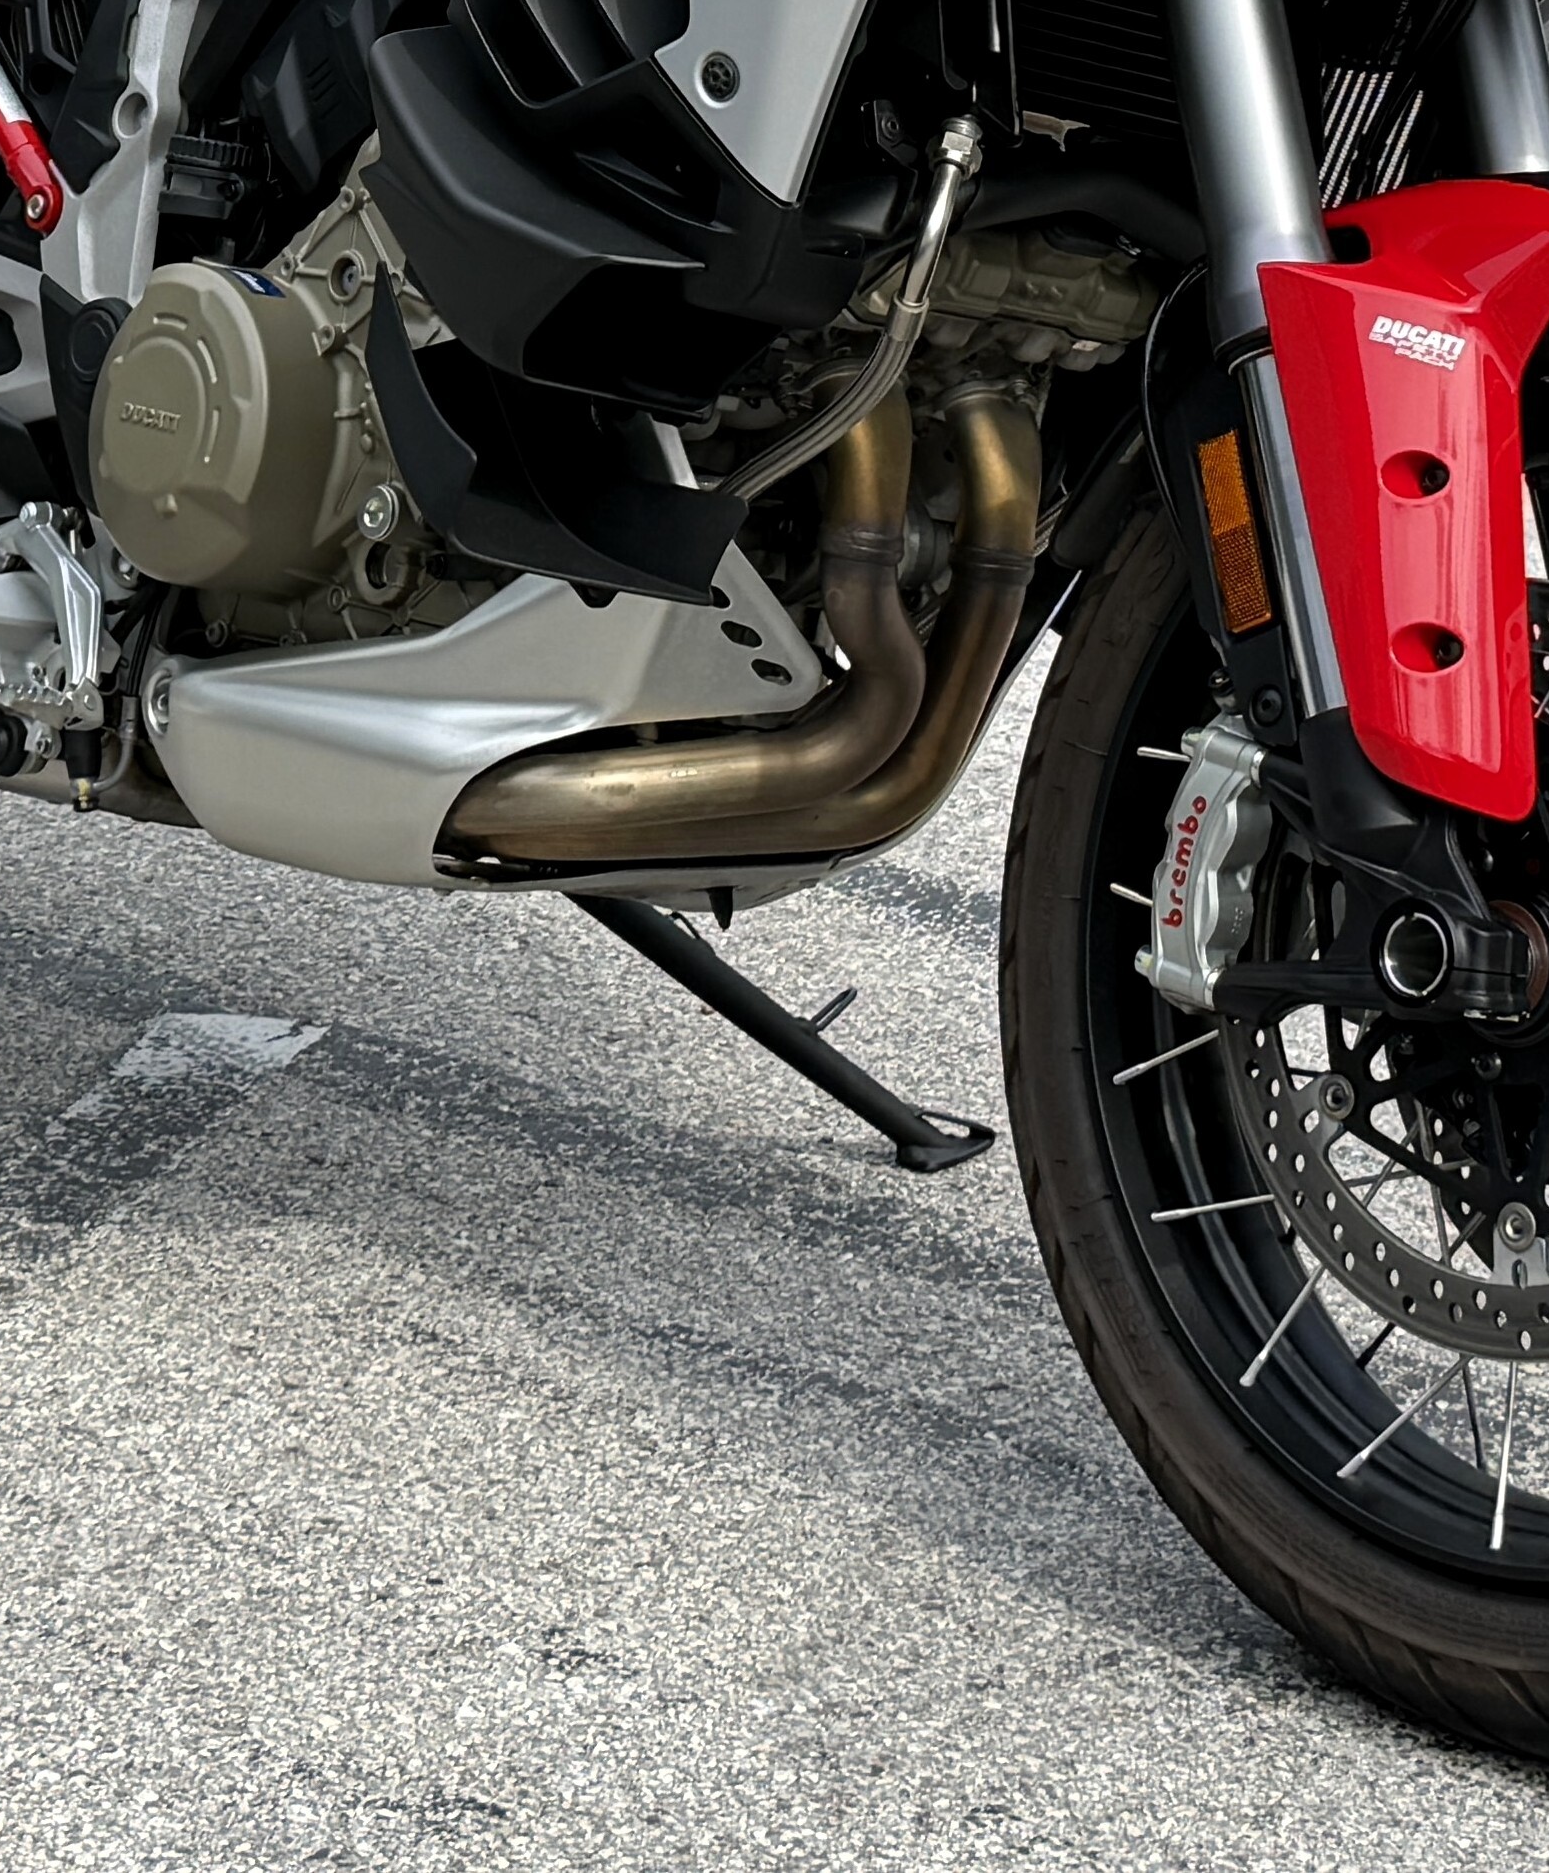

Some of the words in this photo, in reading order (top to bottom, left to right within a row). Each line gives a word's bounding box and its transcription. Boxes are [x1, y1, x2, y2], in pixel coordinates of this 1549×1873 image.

[1371, 315, 1466, 356] DUCATI
[120, 402, 182, 434] DUCATI
[1161, 795, 1207, 928] brembo
